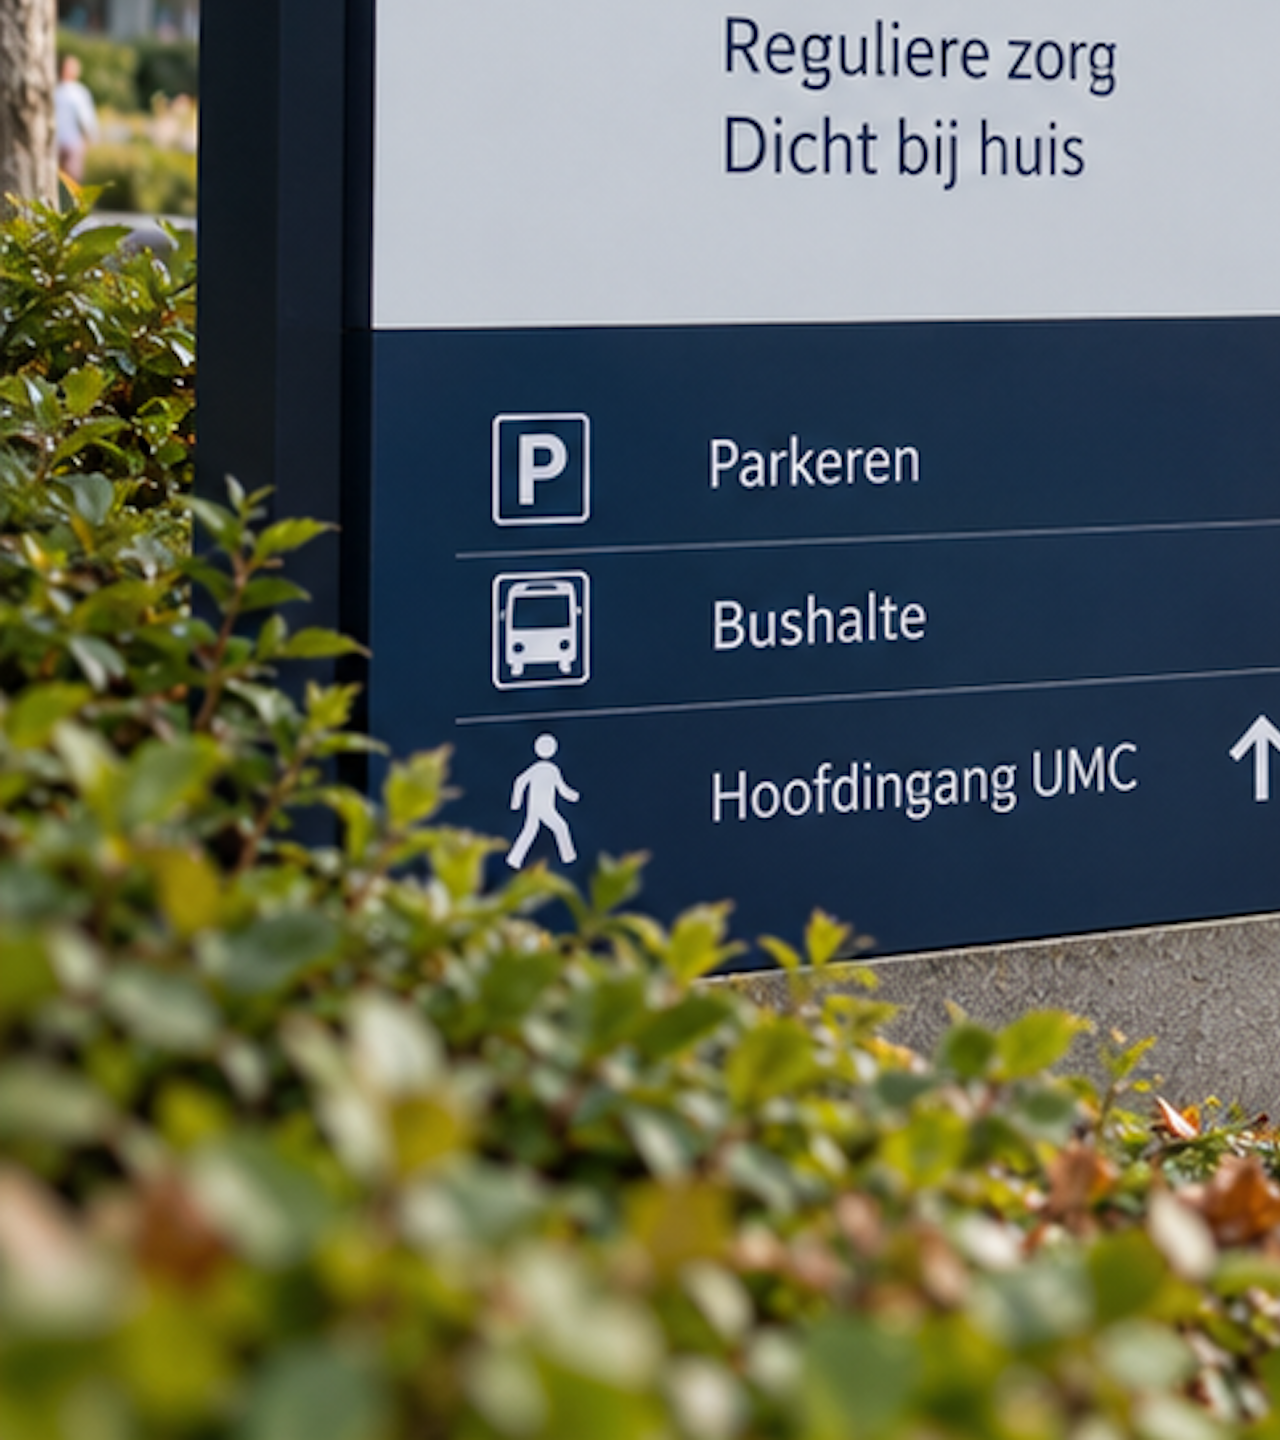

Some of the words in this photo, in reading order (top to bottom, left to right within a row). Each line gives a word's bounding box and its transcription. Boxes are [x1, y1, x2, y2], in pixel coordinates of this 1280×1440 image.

[725, 16, 990, 91] Reguliere
[1007, 39, 1117, 98] zorg
[725, 115, 878, 176] Dicht
[898, 116, 958, 191] bij
[980, 118, 1085, 177] huis
[519, 433, 567, 505] P
[711, 435, 919, 488] Parkeren
[714, 591, 926, 650] Bushalte
[713, 762, 1017, 822] Hoofdingang
[1033, 742, 1137, 797] UMC
